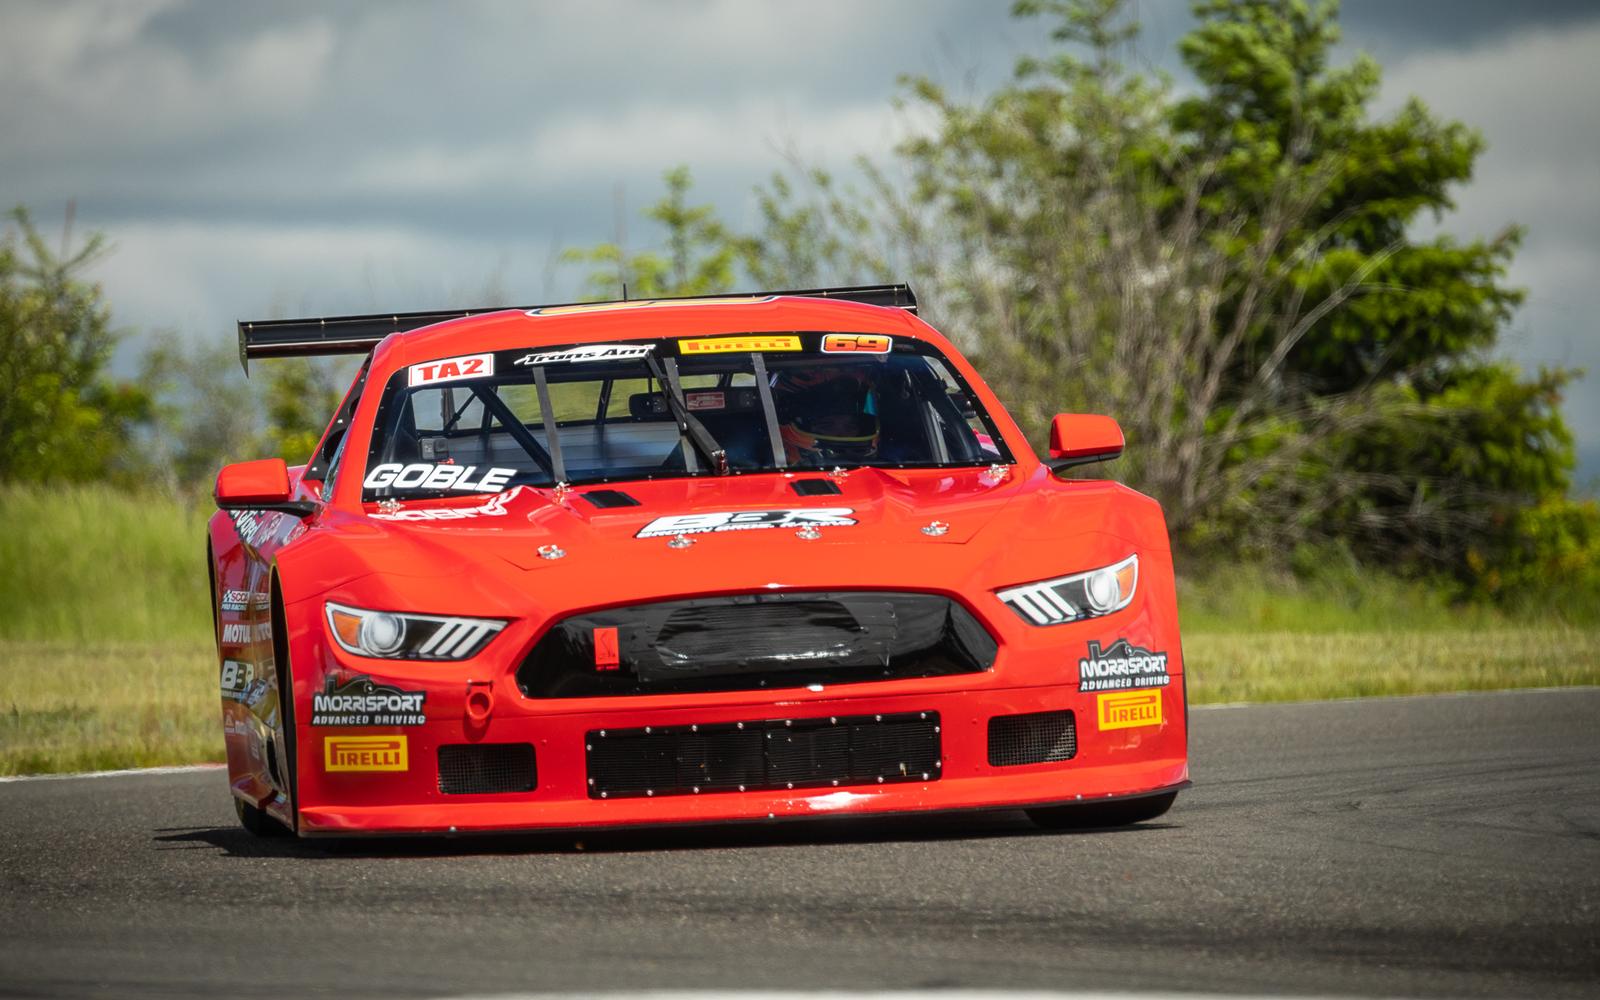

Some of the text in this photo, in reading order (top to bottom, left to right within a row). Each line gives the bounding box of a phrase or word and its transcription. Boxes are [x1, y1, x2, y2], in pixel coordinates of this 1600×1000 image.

[687, 337, 791, 352] PIRELLI
[824, 335, 889, 352] 69
[526, 347, 646, 364] Trans Am
[418, 358, 484, 381] TA2
[363, 463, 517, 493] GOBLE
[1080, 656, 1166, 678] MORRISPORT
[1080, 675, 1170, 691] ADVANCED DRIVING
[314, 695, 424, 712] MORRISPORT
[1103, 695, 1157, 724] PIRELLI
[312, 715, 426, 725] ADVANCED DRIVING
[330, 741, 400, 766] PIRELLI
